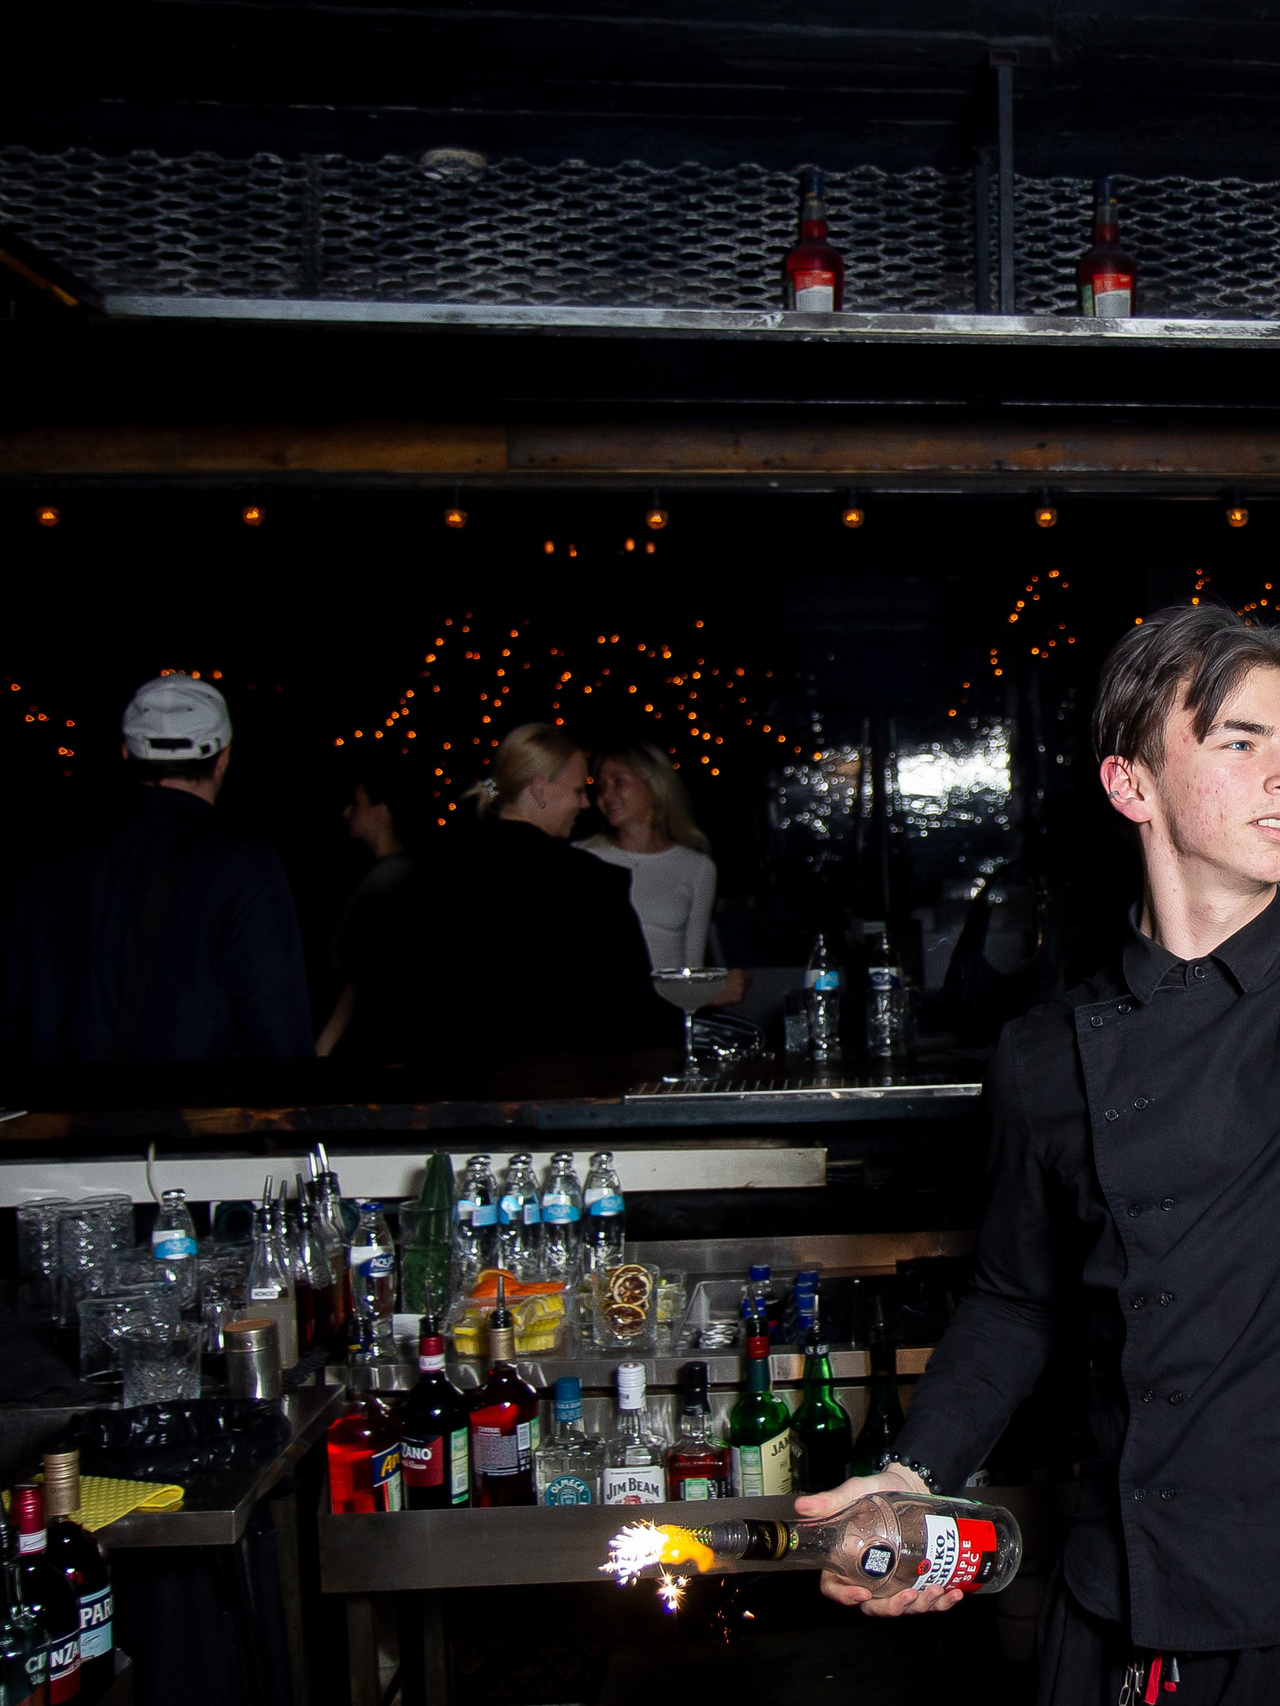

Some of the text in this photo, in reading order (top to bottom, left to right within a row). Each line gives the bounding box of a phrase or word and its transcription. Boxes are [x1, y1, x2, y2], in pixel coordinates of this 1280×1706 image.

[550, 1479, 585, 1493] OLMECA
[606, 1477, 660, 1500] JIM BEAM
[963, 1553, 980, 1581] SEC
